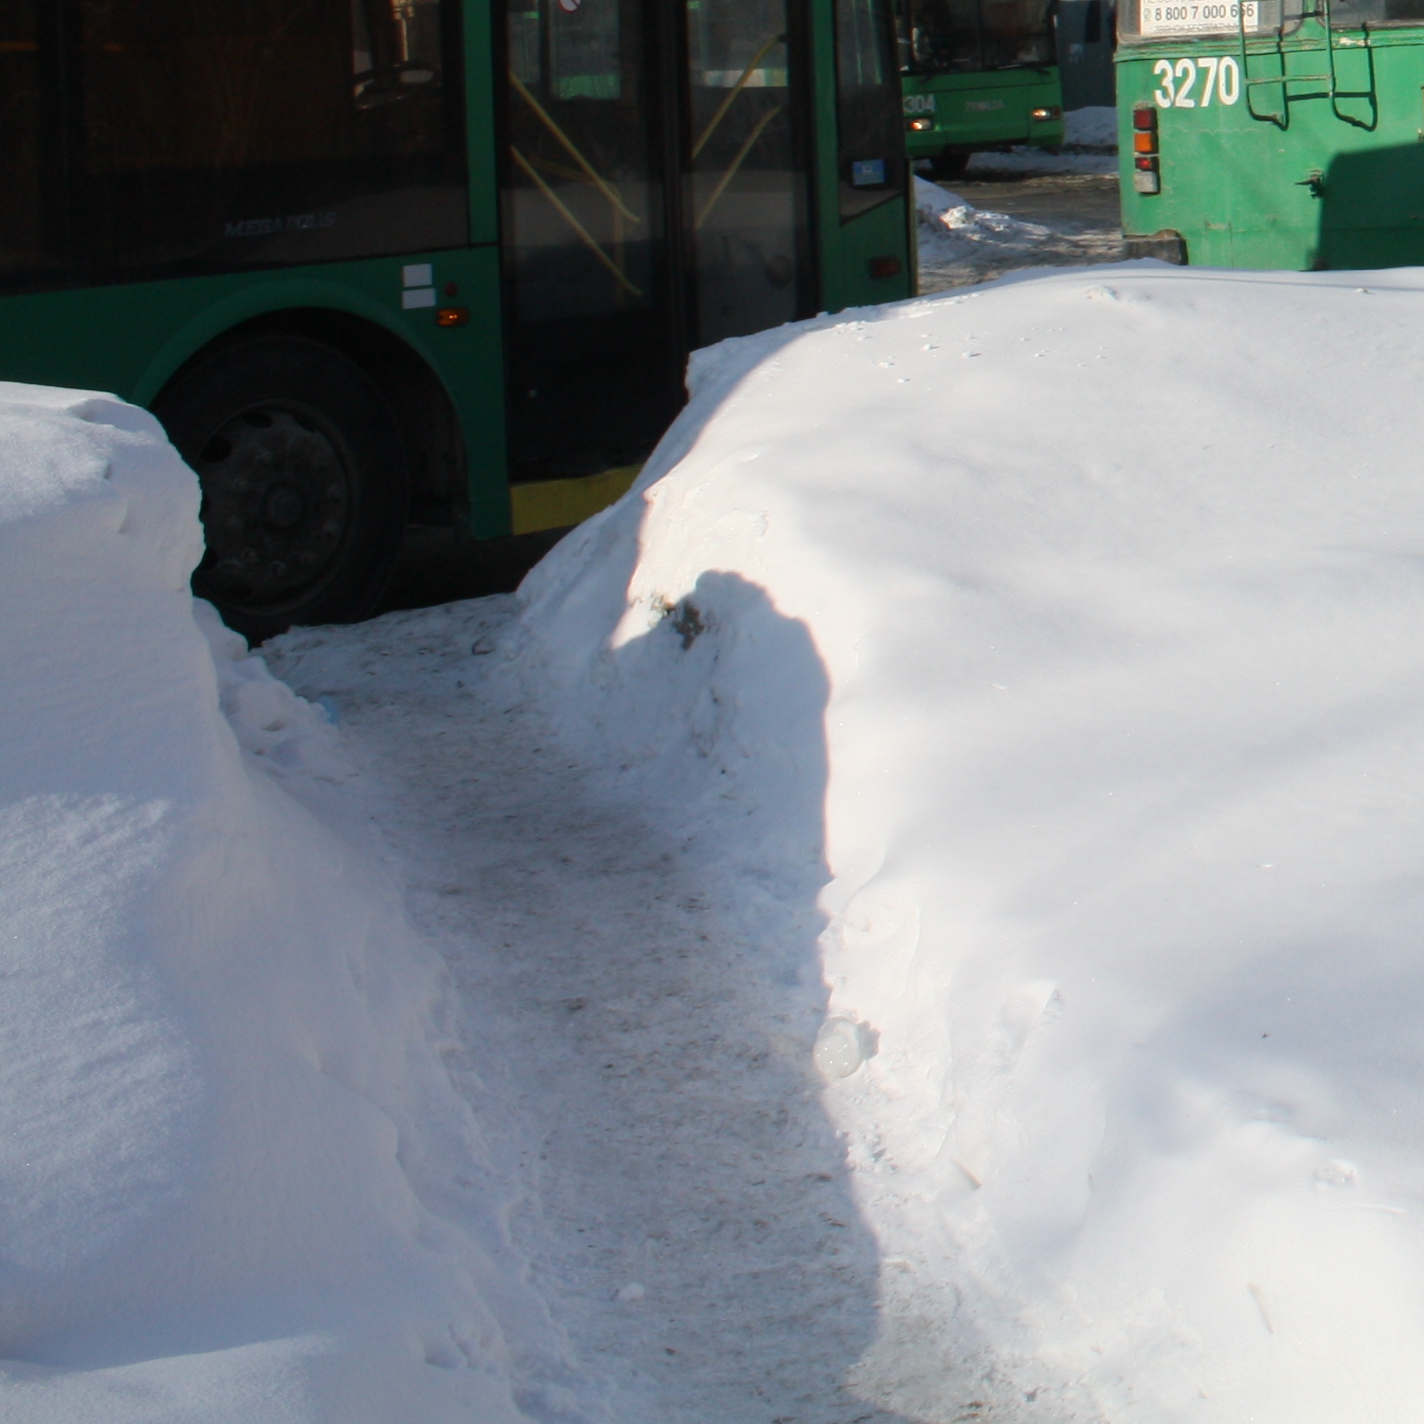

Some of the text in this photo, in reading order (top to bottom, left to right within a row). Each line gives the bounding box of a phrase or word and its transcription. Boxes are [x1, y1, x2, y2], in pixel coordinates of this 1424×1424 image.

[1154, 7, 1163, 21] 8
[1165, 5, 1188, 21] 800
[1191, 4, 1199, 19] 7
[1202, 3, 1227, 19] 000
[1153, 56, 1239, 109] 3270
